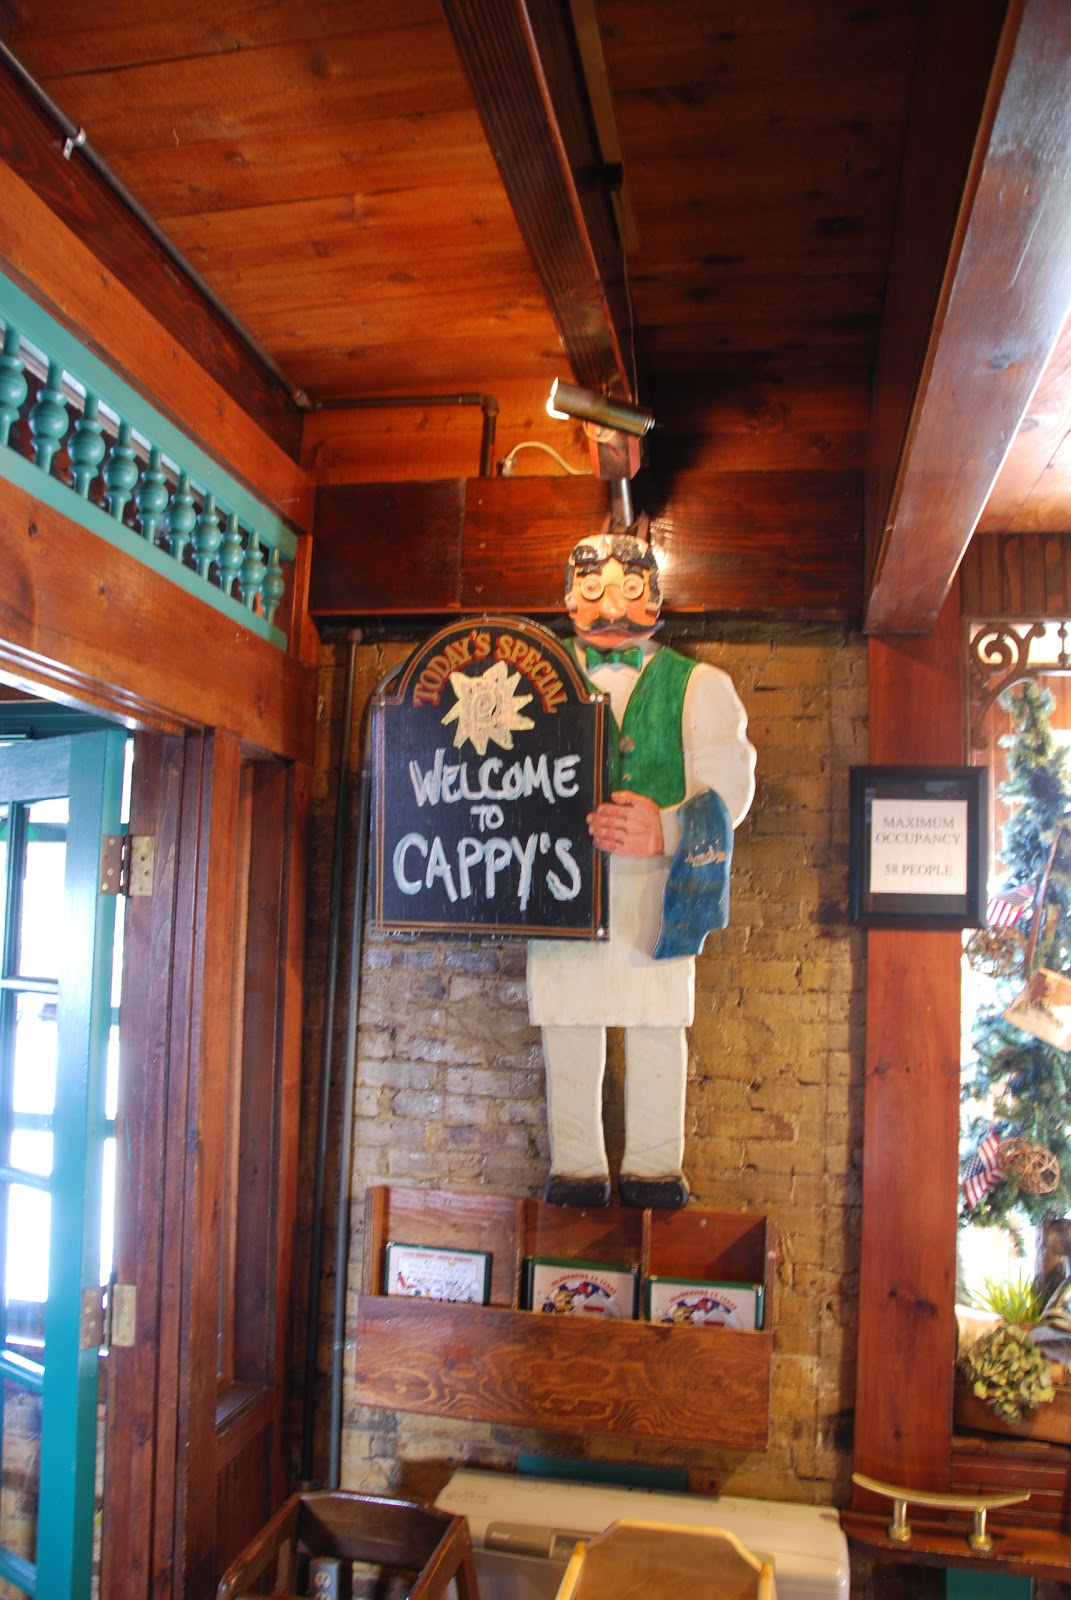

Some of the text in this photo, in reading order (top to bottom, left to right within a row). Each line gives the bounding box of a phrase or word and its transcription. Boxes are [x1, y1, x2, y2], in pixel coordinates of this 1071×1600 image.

[413, 630, 568, 714] TODAY'S SPECIAL
[409, 748, 581, 806] WELCOME
[470, 804, 504, 832] TO
[883, 816, 955, 830] MAXIMUM
[875, 832, 961, 846] OCCUPANCY
[392, 832, 581, 911] CAPPY'S
[884, 864, 953, 877] 58 PEOPLE
